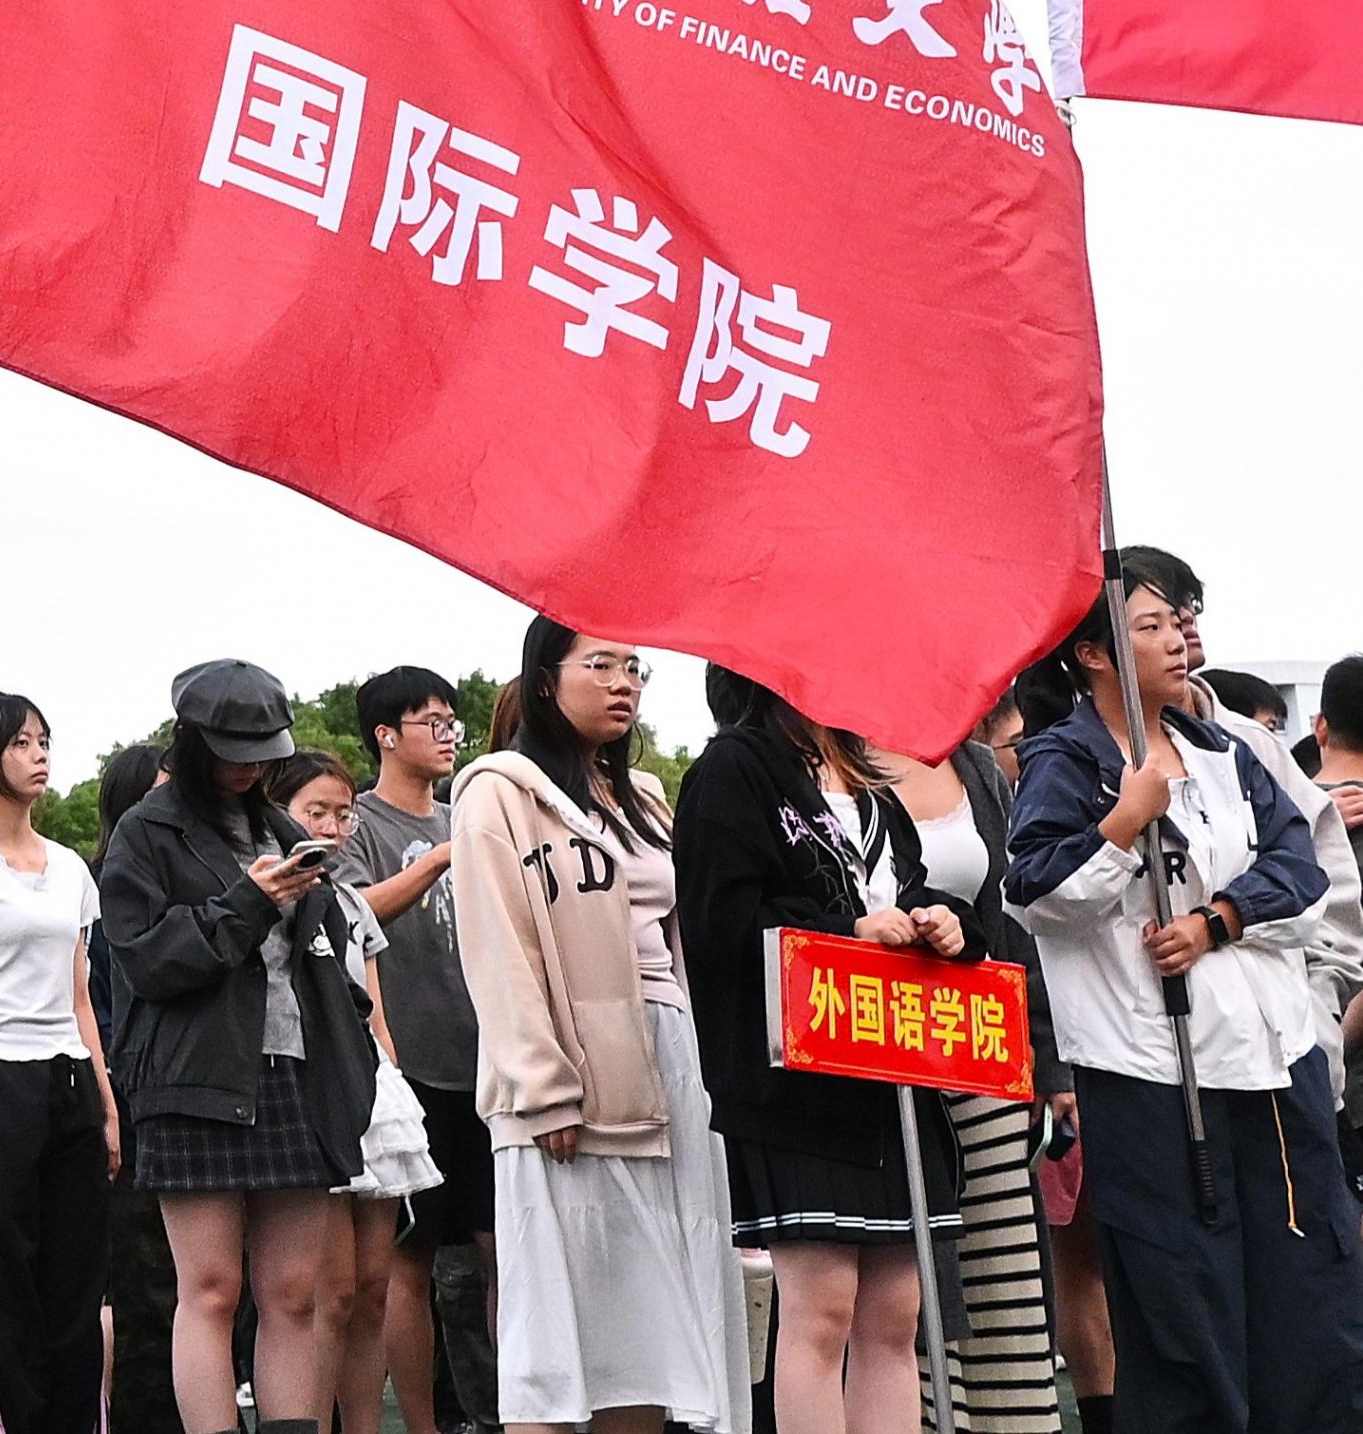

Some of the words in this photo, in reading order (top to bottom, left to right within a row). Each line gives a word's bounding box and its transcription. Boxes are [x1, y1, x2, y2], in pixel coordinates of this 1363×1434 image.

[634, 2, 676, 31] OF
[679, 16, 805, 80] FINANCE
[811, 65, 878, 102] AND
[884, 86, 1046, 157] ECONOMICS
[199, 23, 832, 458] 国际学院
[808, 967, 1009, 1062] 外国语学院
